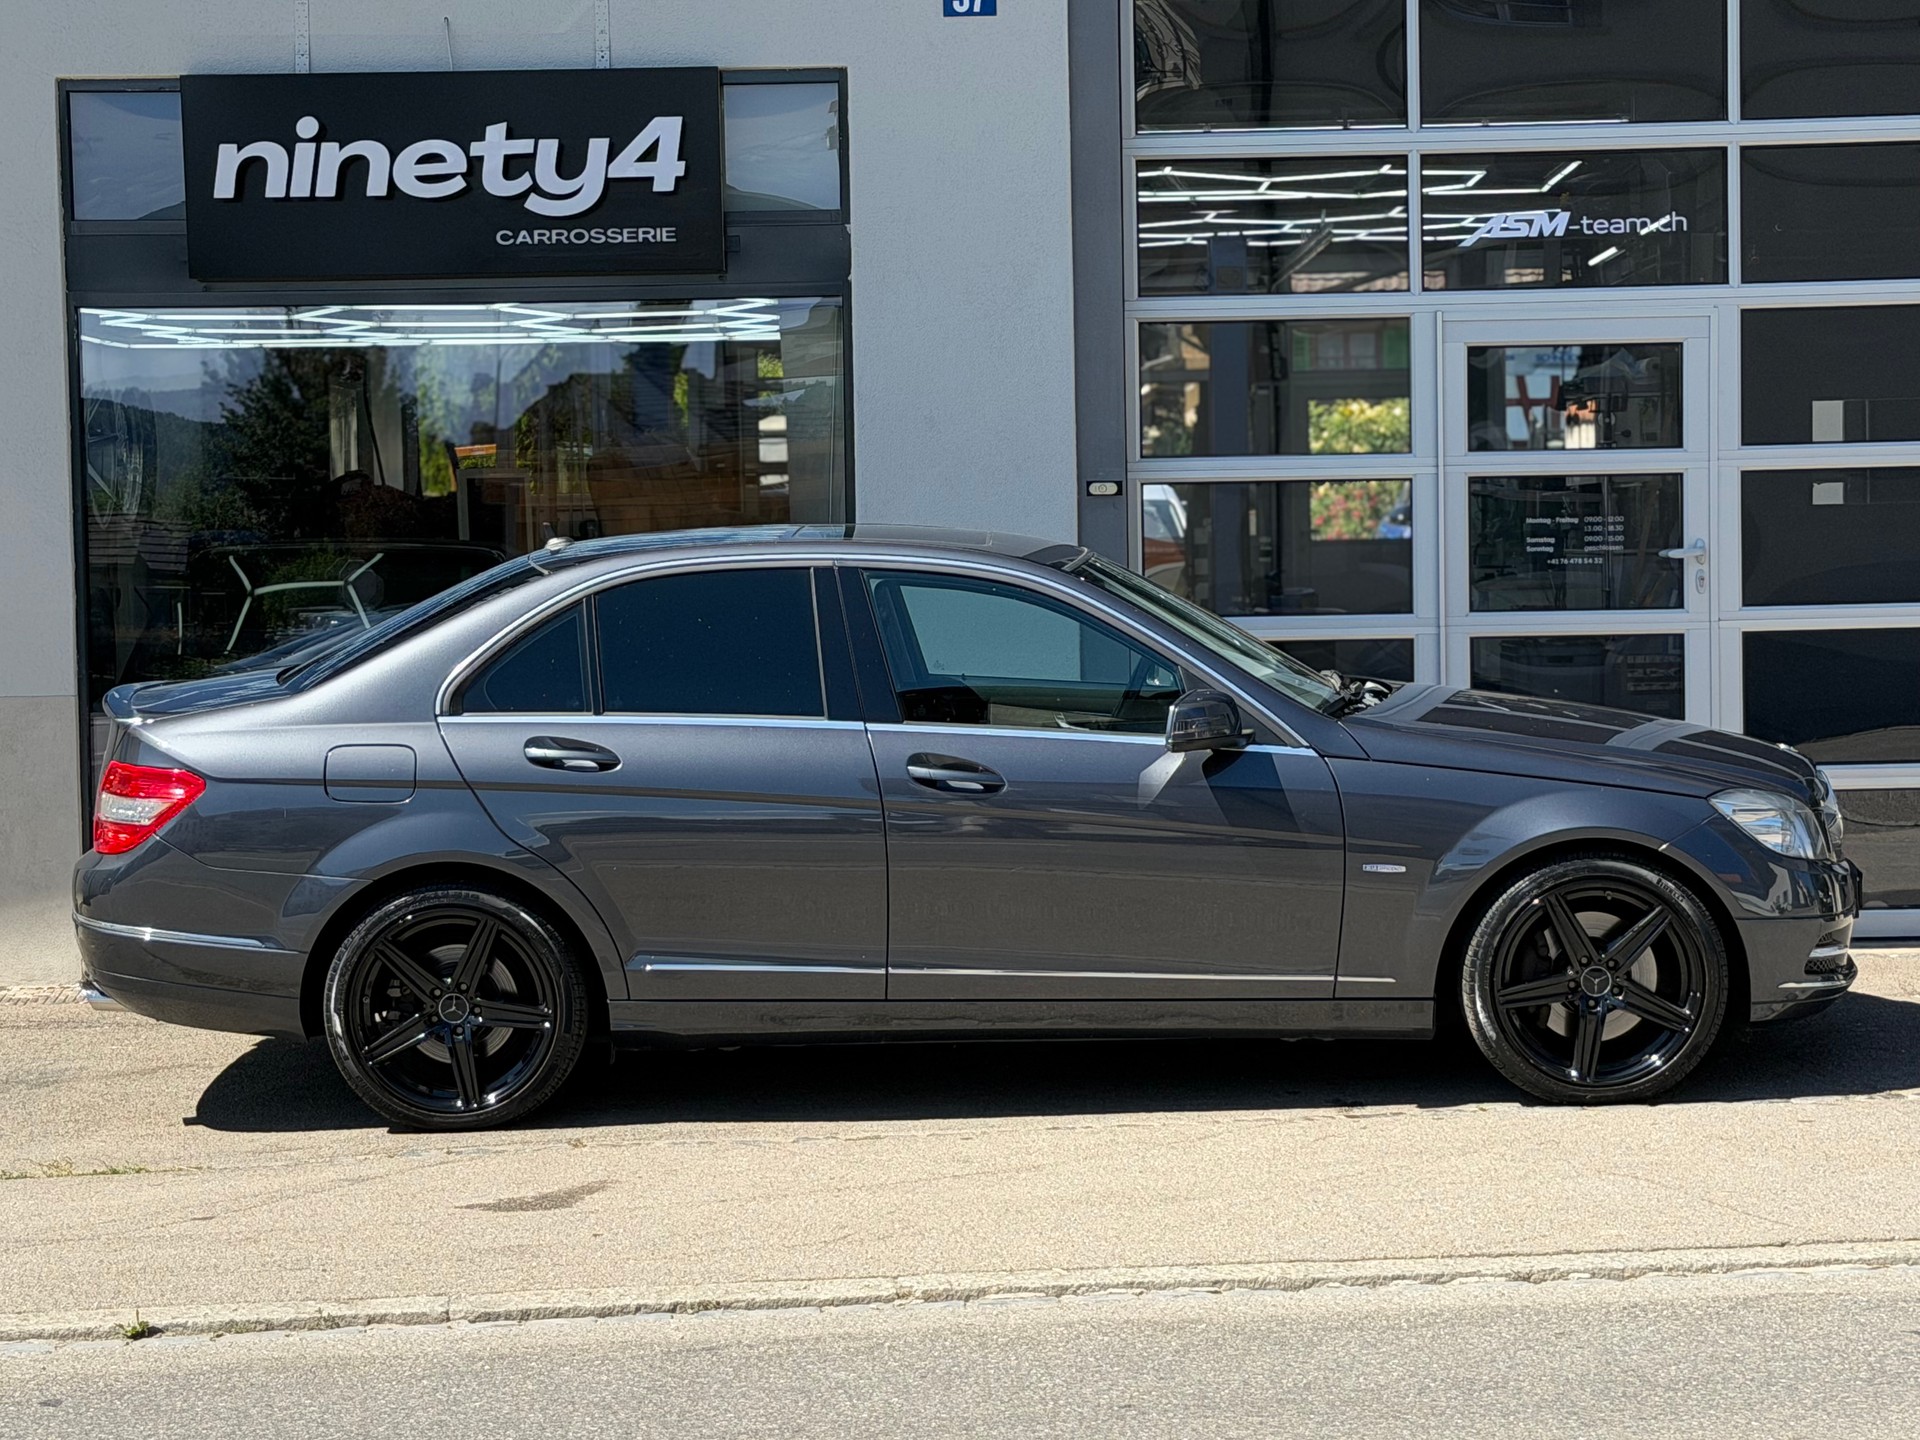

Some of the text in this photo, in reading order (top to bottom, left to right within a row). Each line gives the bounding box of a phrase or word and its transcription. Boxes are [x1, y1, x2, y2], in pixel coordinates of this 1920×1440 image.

[213, 115, 686, 216] ninety4
[495, 226, 677, 246] CARROSSERIE
[1457, 210, 1688, 247] ASM-team.ch
[1556, 516, 1579, 524] Freitag
